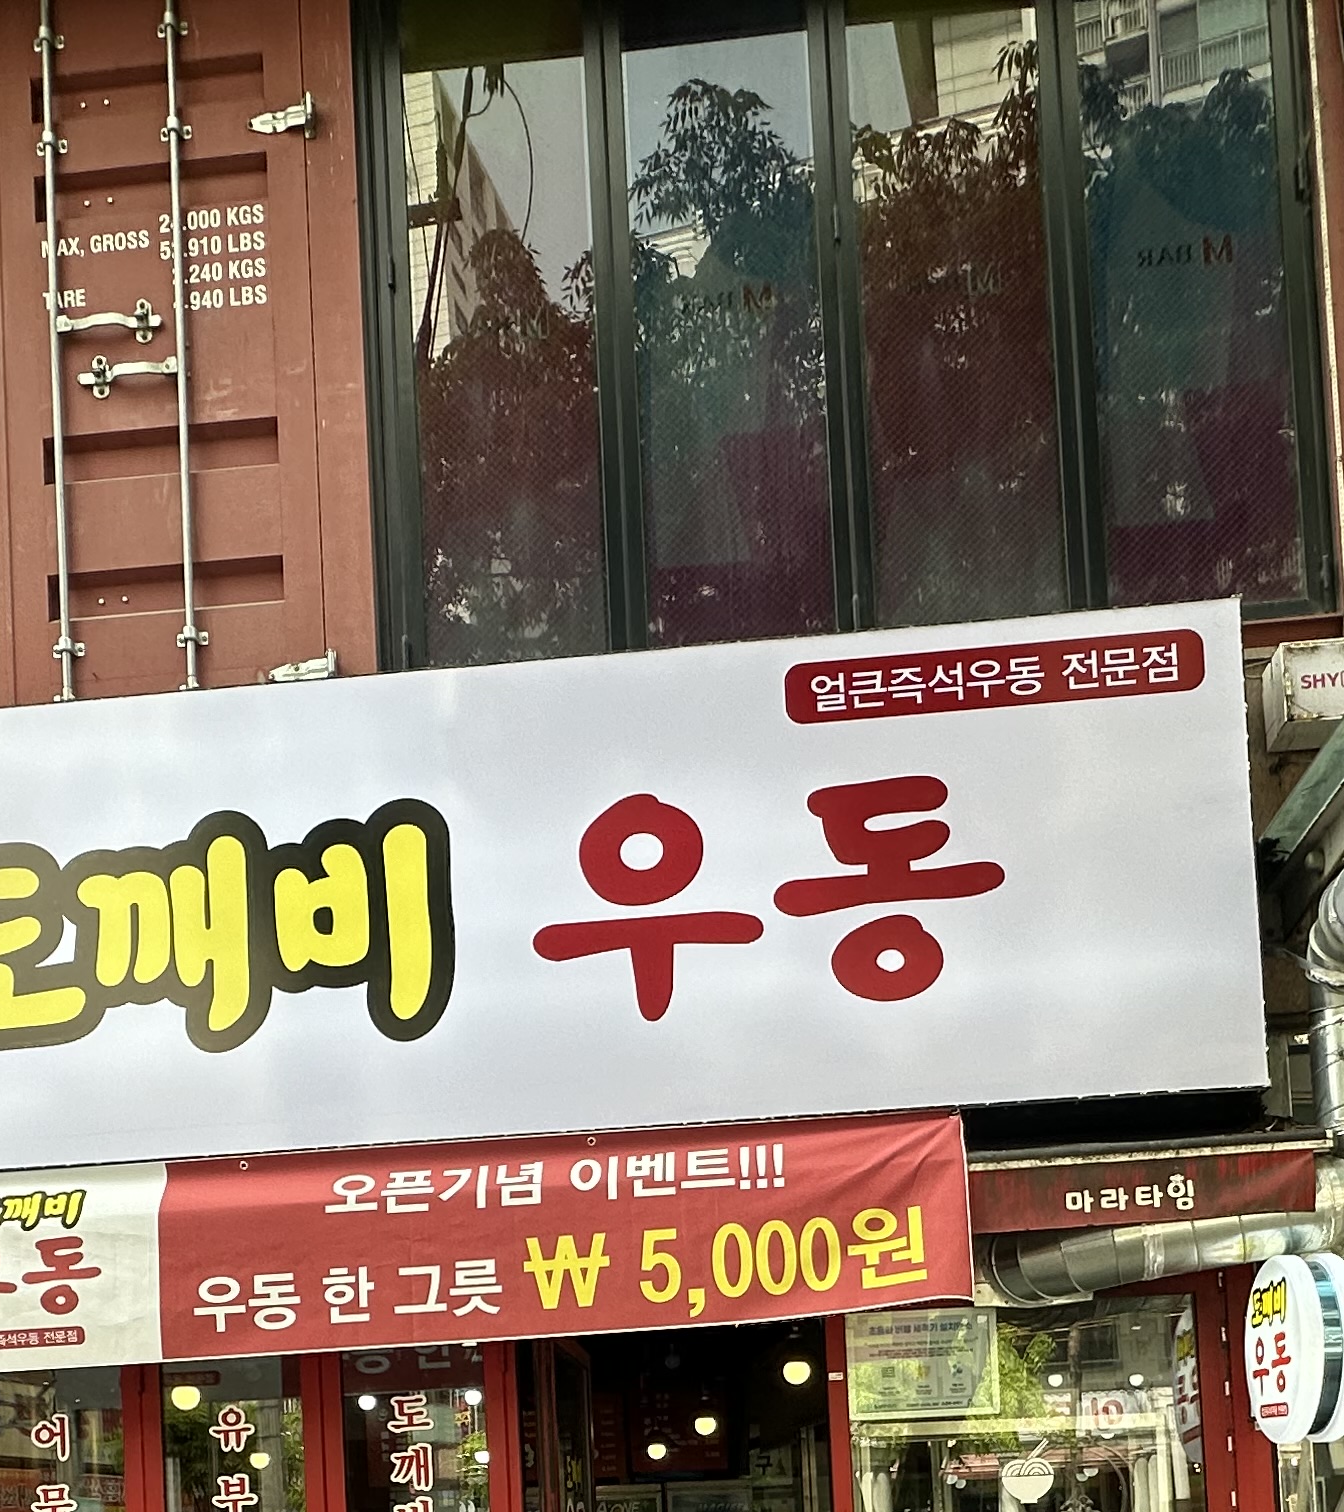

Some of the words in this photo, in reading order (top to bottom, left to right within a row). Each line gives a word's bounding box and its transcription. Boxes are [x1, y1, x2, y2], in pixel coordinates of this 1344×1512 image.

[159, 208, 221, 233] 2.000
[226, 203, 264, 226] KGS
[90, 230, 150, 254] GROSS
[159, 235, 222, 260] 5.910
[228, 231, 266, 254] LBS
[172, 262, 224, 284] .240
[228, 258, 267, 280] KGS
[173, 289, 224, 310] .940
[230, 285, 268, 306] LBS
[809, 653, 1045, 712] 얼큰즉석우동
[1061, 642, 1181, 692] 전문점
[532, 775, 1006, 1022] 우동
[325, 1159, 544, 1214] 오픈기념
[569, 1143, 787, 1201] 이벤트!!!
[193, 1272, 302, 1333] 우동
[322, 1266, 375, 1325] 한
[393, 1258, 503, 1318] 그릇
[639, 1205, 929, 1318] 5,000원
[1251, 1276, 1286, 1328] 도깨비
[44, 1330, 78, 1343] 전문점
[1252, 1331, 1291, 1397] 우동
